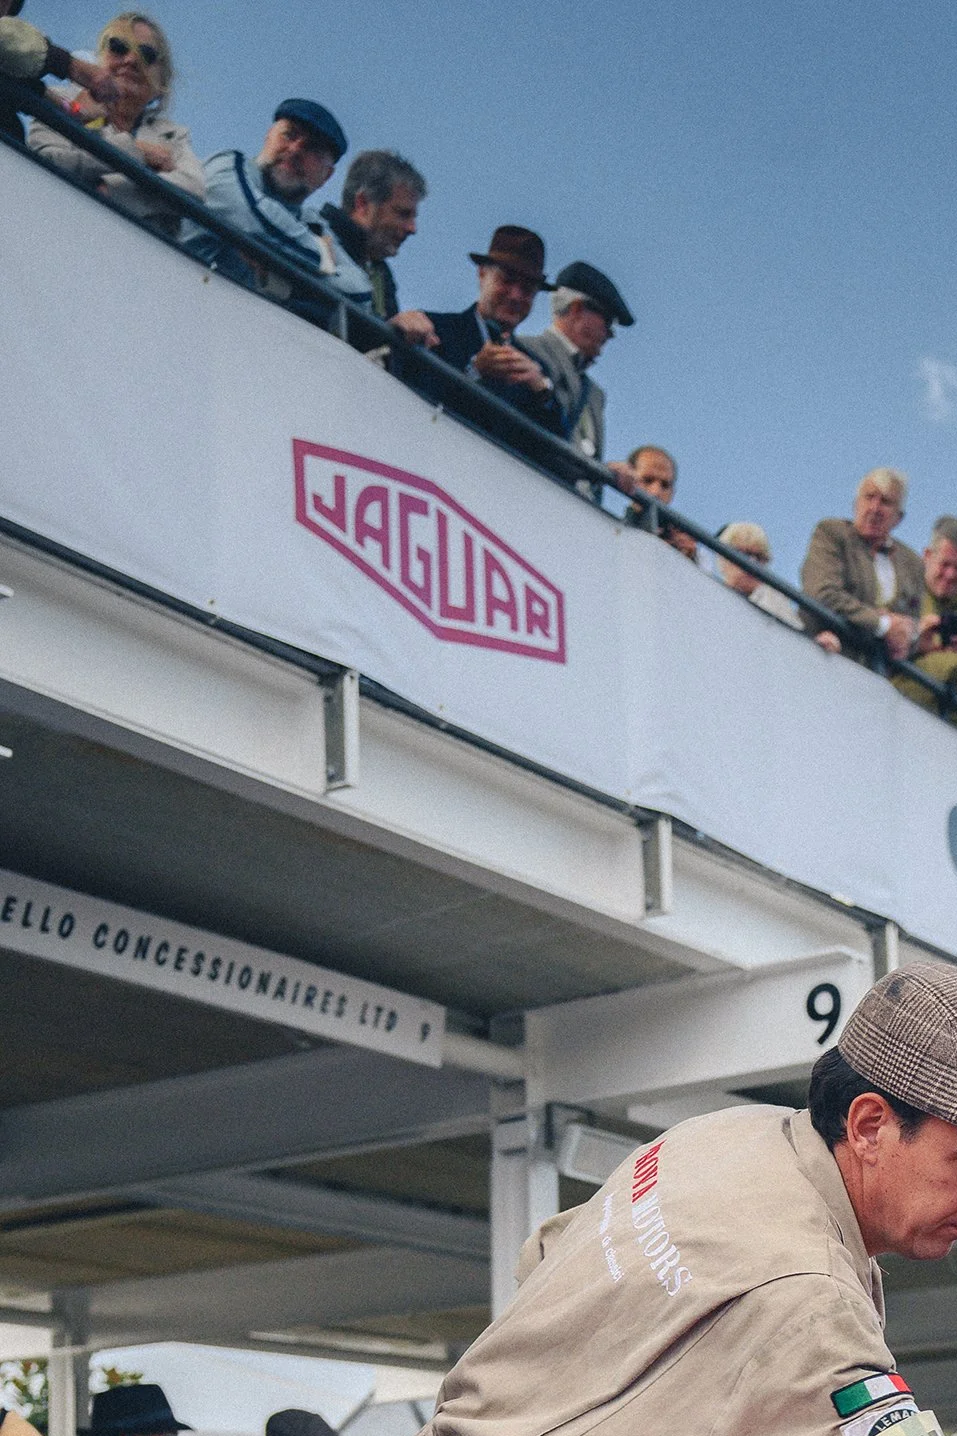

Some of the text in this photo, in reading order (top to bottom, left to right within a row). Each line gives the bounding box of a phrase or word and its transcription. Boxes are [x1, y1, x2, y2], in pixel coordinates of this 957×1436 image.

[312, 474, 551, 639] JAGUAR
[92, 923, 348, 1019] CONCESSIONAIRES
[359, 1000, 399, 1033] LTD
[806, 983, 841, 1045] 9
